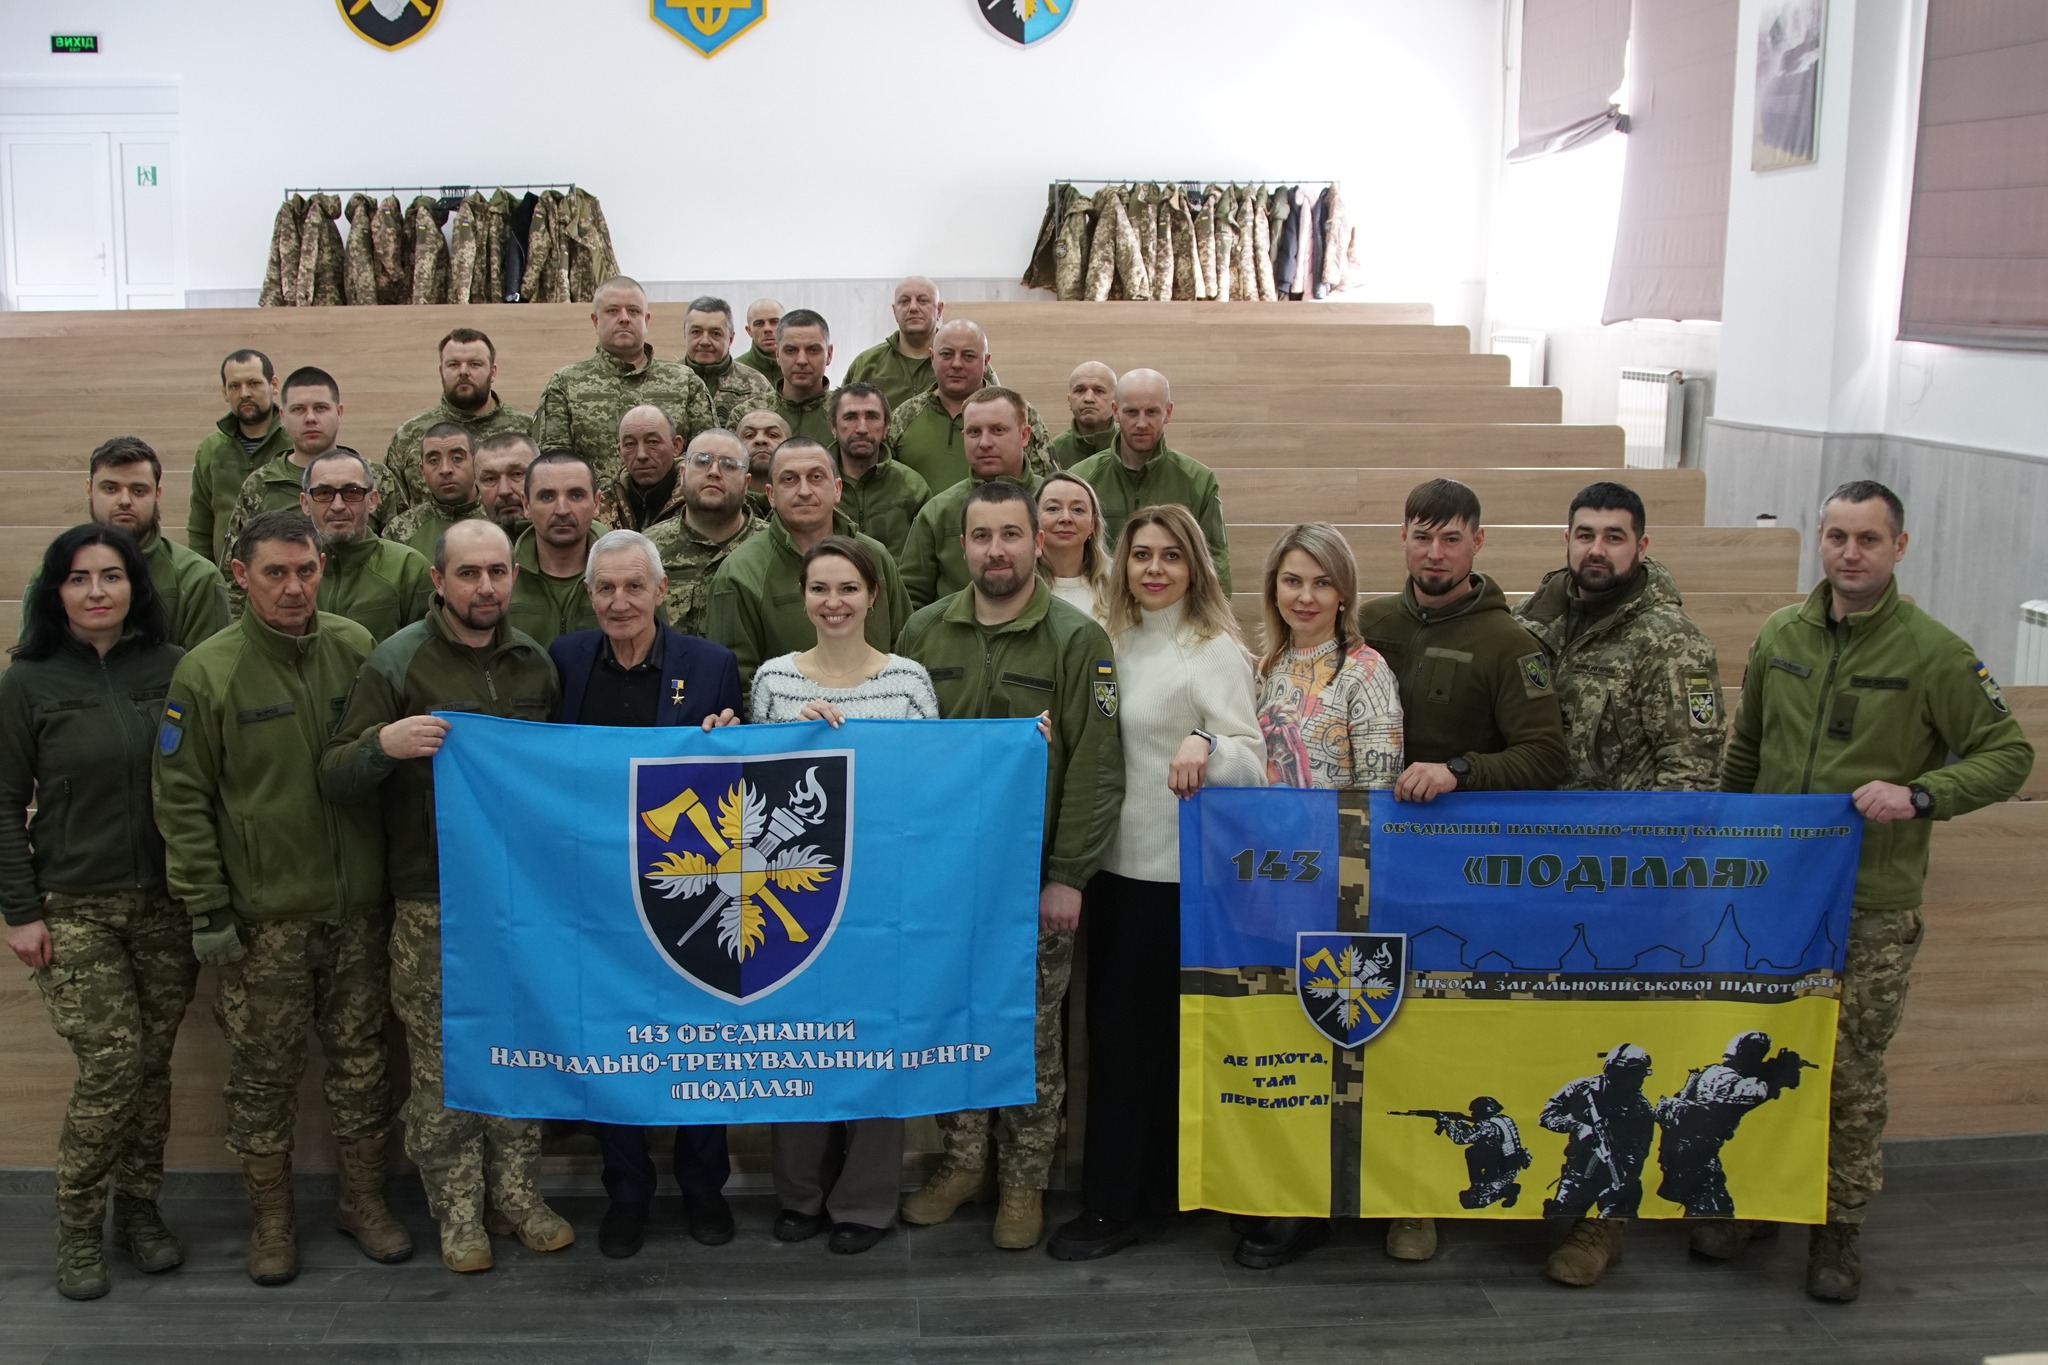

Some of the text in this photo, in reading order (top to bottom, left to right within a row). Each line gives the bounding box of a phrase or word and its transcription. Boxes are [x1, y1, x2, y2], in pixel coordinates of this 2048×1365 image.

[55, 37, 94, 49] ВИХІД
[1382, 821, 1851, 844] ОБ'ЄДНАНИЙ НАВЧАЛЬНО-ТРЕНУВАЛЬНИЙ ЦЕНТР
[1231, 849, 1322, 882] 143
[1462, 853, 1770, 893] «ПОДІЛЛЯ»
[1414, 977, 1487, 991] ШКОЛА
[1494, 977, 1713, 992] ЗАГАЛЬНОВІЙСЬКОВОЇ
[627, 1019, 856, 1046] 143 ОБ'ЄДНАНИЙ
[489, 1043, 992, 1075] НАВЧАЛЬНО-ТРЕНУВАЛЬНИЙ ЦЕНТР
[1223, 1051, 1328, 1068] ДЕ ПІХОТА,
[670, 1077, 815, 1103] «ПОДІЛЛЯ»
[1252, 1074, 1297, 1088] ТАМ
[1220, 1093, 1330, 1109] ПЕРЕМОГА!
